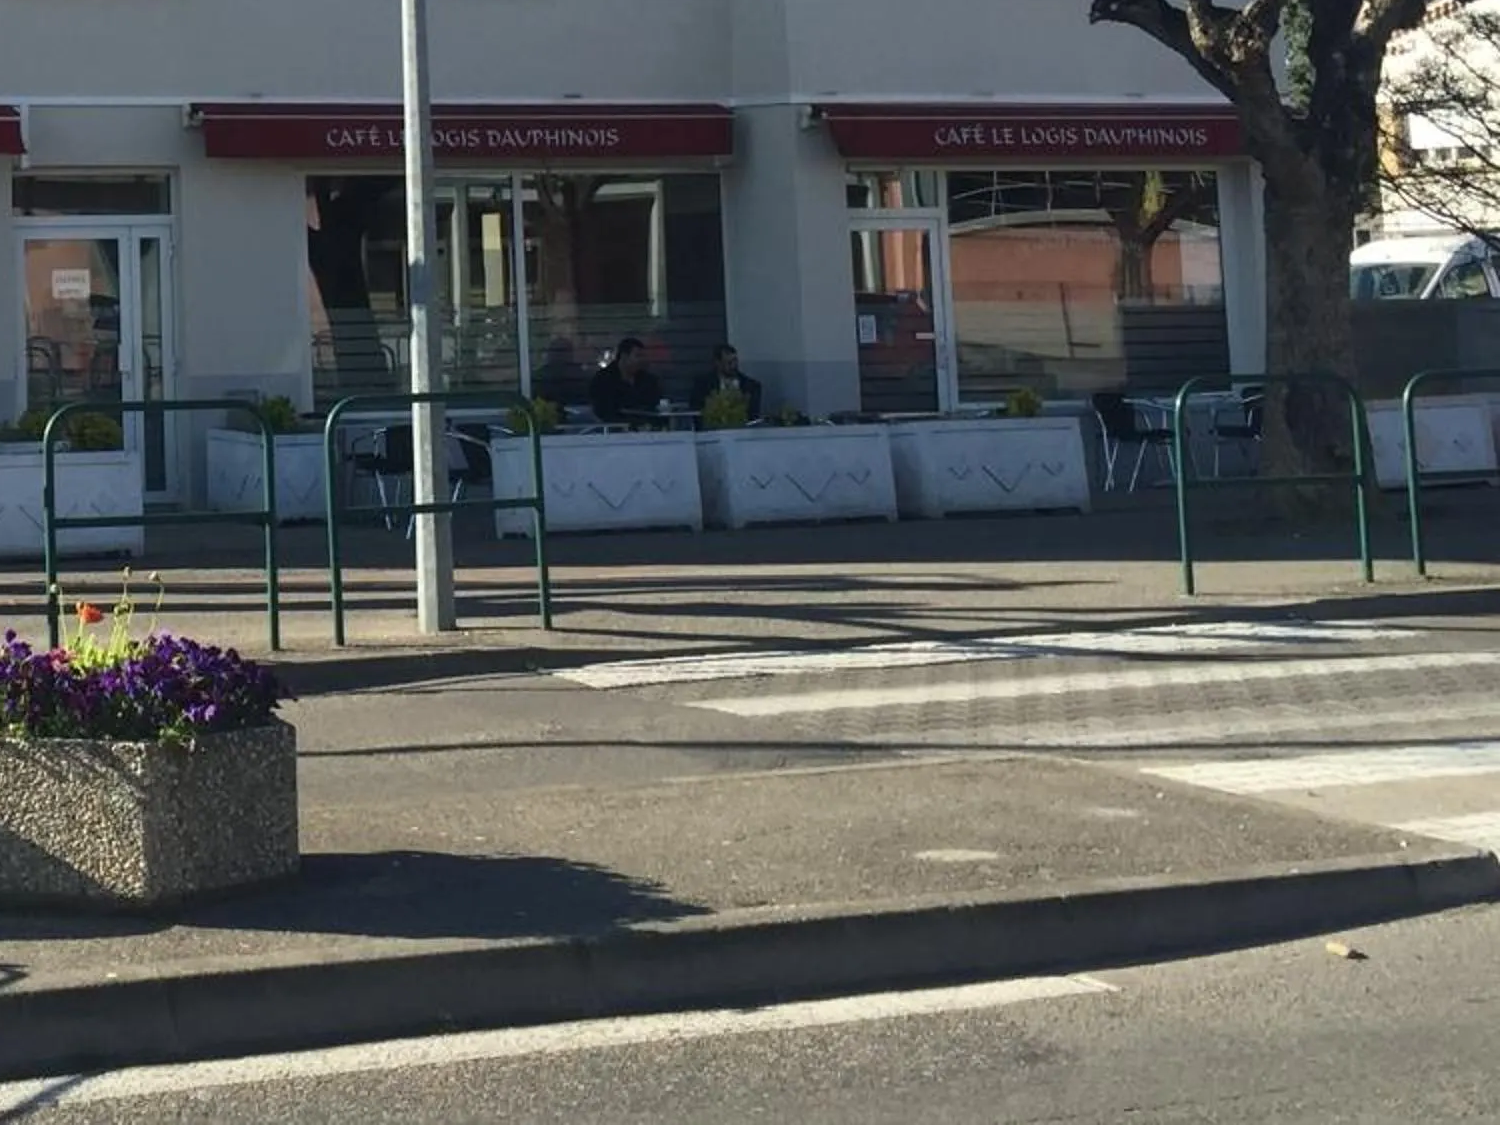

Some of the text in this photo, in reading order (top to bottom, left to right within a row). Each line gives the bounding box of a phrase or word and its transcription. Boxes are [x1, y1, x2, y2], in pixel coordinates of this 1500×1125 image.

[326, 124, 382, 148] CAFÉ
[429, 127, 482, 147] OGIS
[486, 127, 621, 147] DAUPHINOIS
[934, 123, 1209, 147] CAFÉ LE LOGIS DAUPHINOIS
